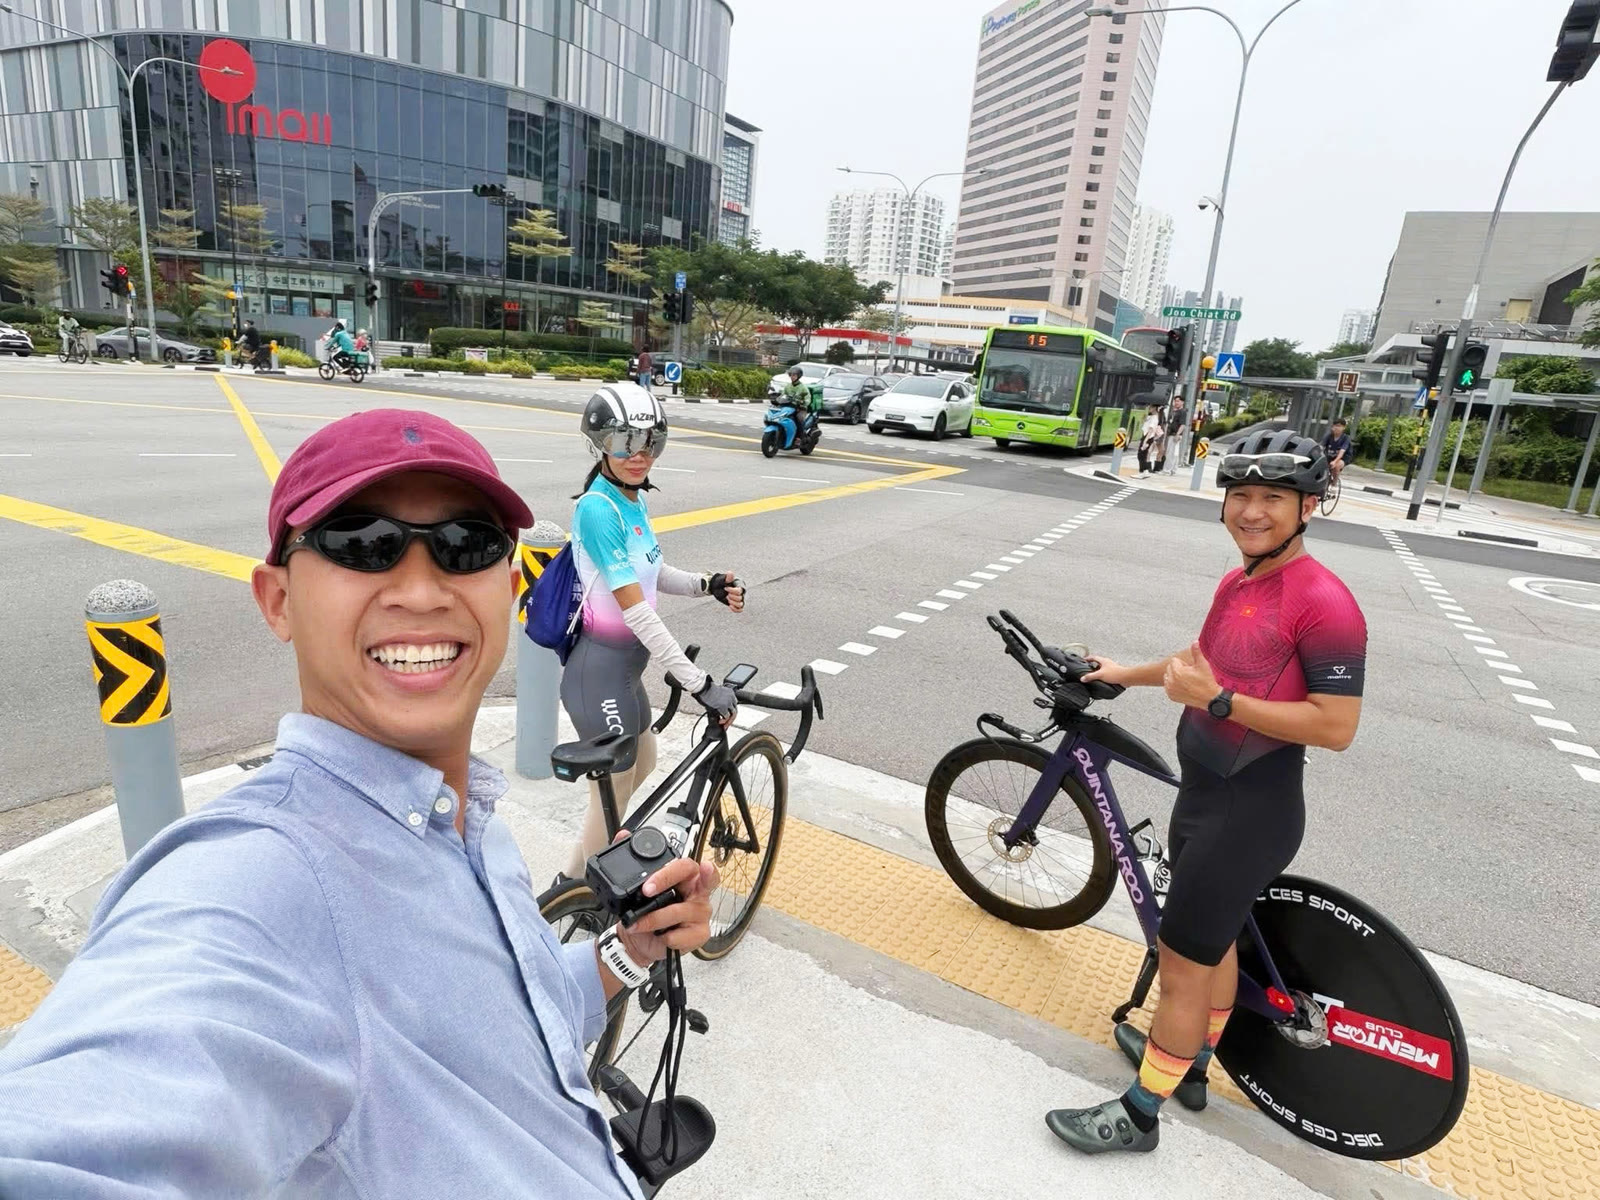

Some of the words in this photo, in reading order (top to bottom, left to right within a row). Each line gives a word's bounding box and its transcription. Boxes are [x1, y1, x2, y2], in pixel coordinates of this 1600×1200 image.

[1168, 308, 1186, 317] Joo
[1190, 309, 1219, 319] Chiat
[1223, 311, 1237, 320] Rd
[1027, 334, 1048, 346] 15
[1073, 747, 1125, 856] QUINTANA
[1118, 855, 1144, 905] ROO
[1269, 888, 1304, 903] CES
[1308, 894, 1376, 937] SPORT
[1365, 1021, 1404, 1039] CLUB
[1332, 1020, 1440, 1069] MENTOR
[1240, 1074, 1297, 1123] SPORT
[1301, 1118, 1338, 1142] CES
[1341, 1133, 1384, 1147] DISC
